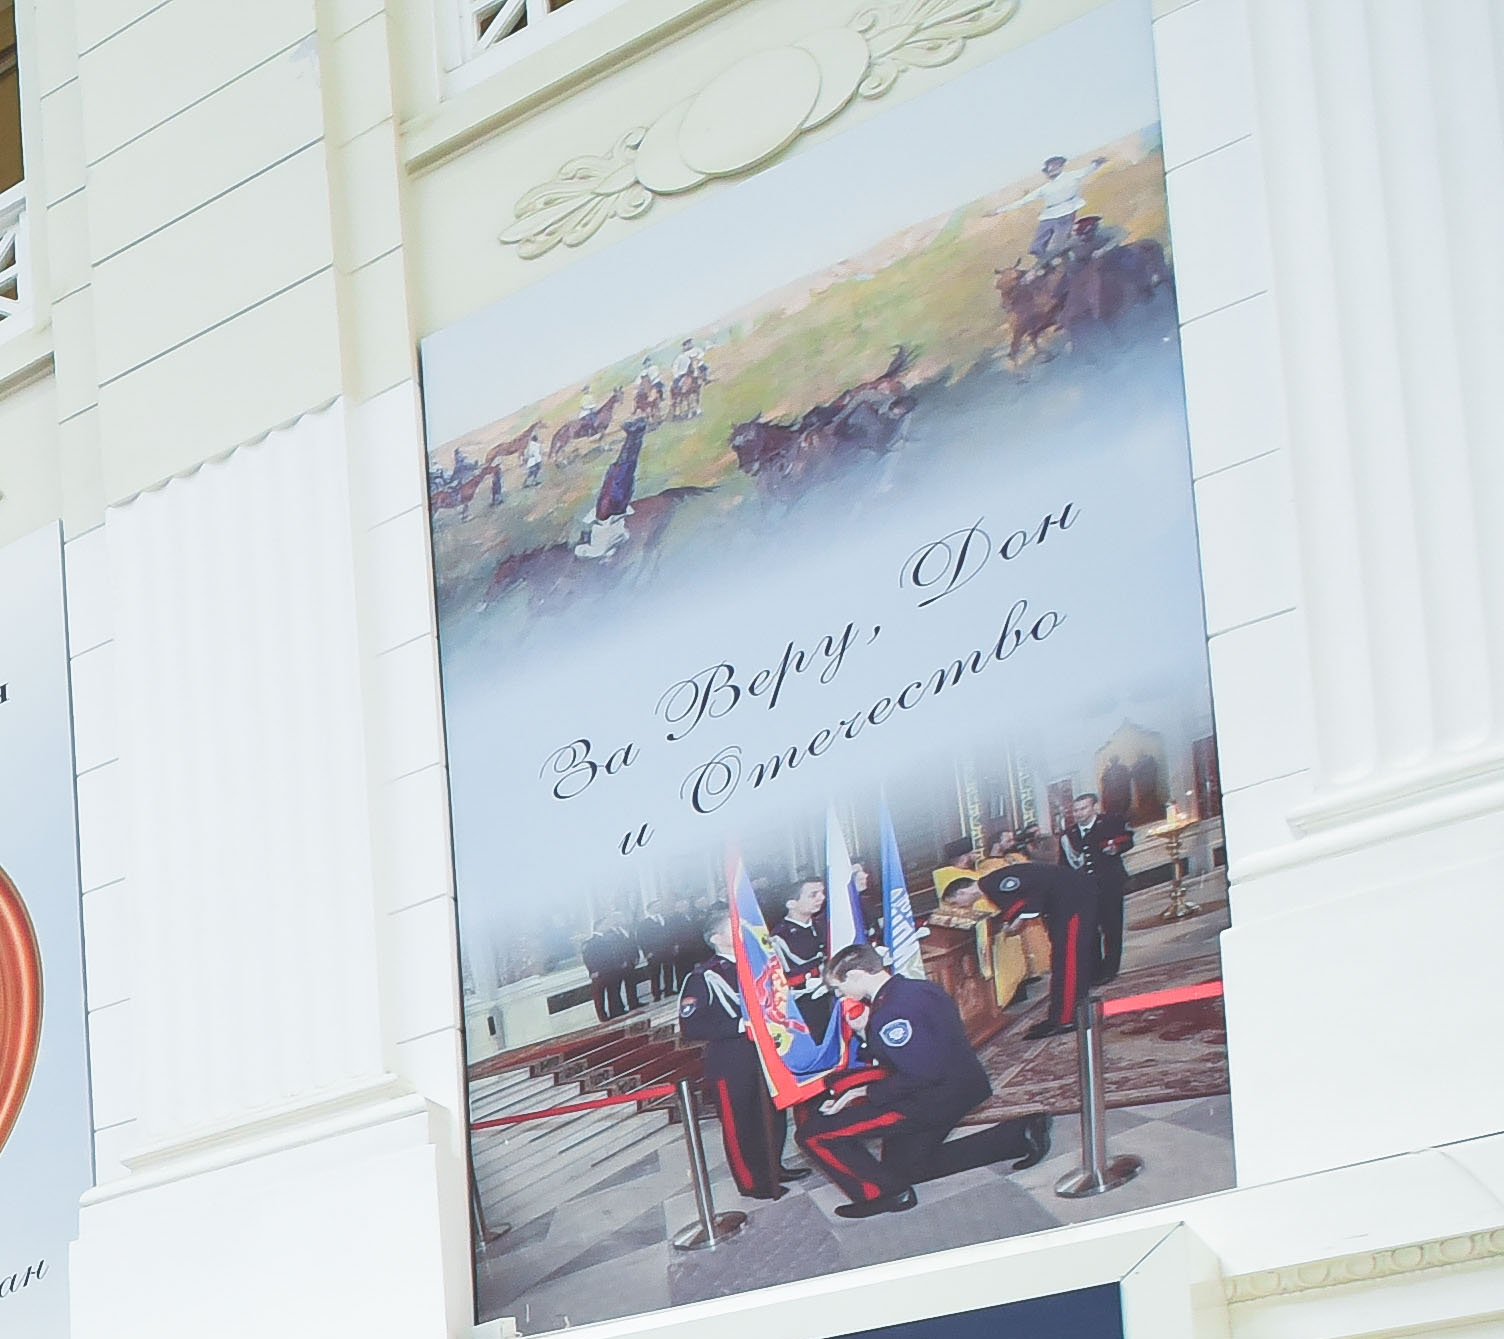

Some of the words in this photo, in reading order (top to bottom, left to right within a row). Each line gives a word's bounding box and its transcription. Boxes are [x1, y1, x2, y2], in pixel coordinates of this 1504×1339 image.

[539, 737, 641, 801] За
[654, 621, 882, 742] Веру,
[899, 501, 1082, 608] Дон
[617, 822, 656, 856] и
[679, 599, 1068, 815] Отечество
